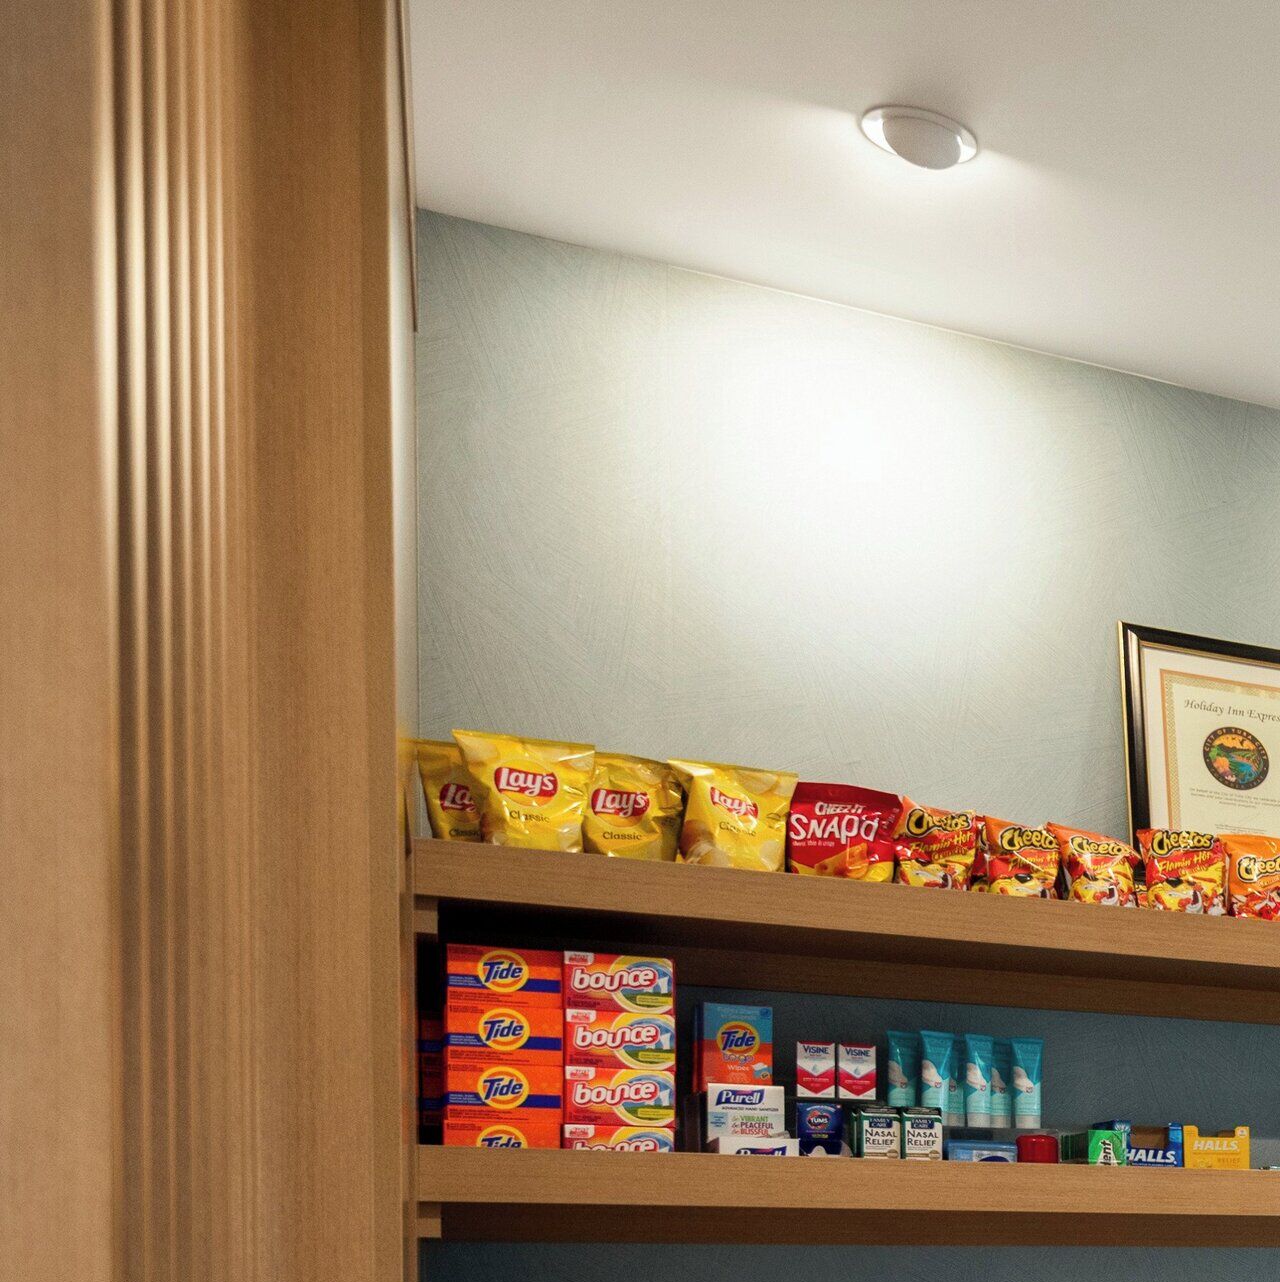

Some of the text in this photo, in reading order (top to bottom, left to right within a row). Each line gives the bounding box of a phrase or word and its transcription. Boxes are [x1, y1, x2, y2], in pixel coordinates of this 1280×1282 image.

[1184, 699, 1224, 716] Holiday
[1227, 705, 1245, 717] Inn
[499, 767, 554, 796] Lay's
[595, 789, 648, 817] Lay's
[509, 810, 550, 823] Classic
[907, 808, 971, 837] Cheetos
[603, 831, 642, 841] Classic
[1152, 830, 1213, 855] Cheetos
[483, 961, 523, 983] Tide
[573, 968, 655, 991] bounce
[484, 1019, 524, 1042] Tide
[575, 1025, 657, 1049] bounce
[721, 1031, 756, 1050] Tide
[803, 1045, 829, 1054] VISINE
[845, 1047, 871, 1057] VISINE
[727, 1064, 749, 1072] Wipes
[483, 1077, 523, 1100] Tide
[575, 1081, 656, 1106] bounce
[740, 1128, 770, 1136] BLISSFUL
[866, 1129, 897, 1138] NASAL
[907, 1130, 938, 1139] NASAL
[866, 1138, 894, 1146] RELIEF
[1193, 1140, 1238, 1151] HALLS
[1124, 1148, 1175, 1163] HALLS
